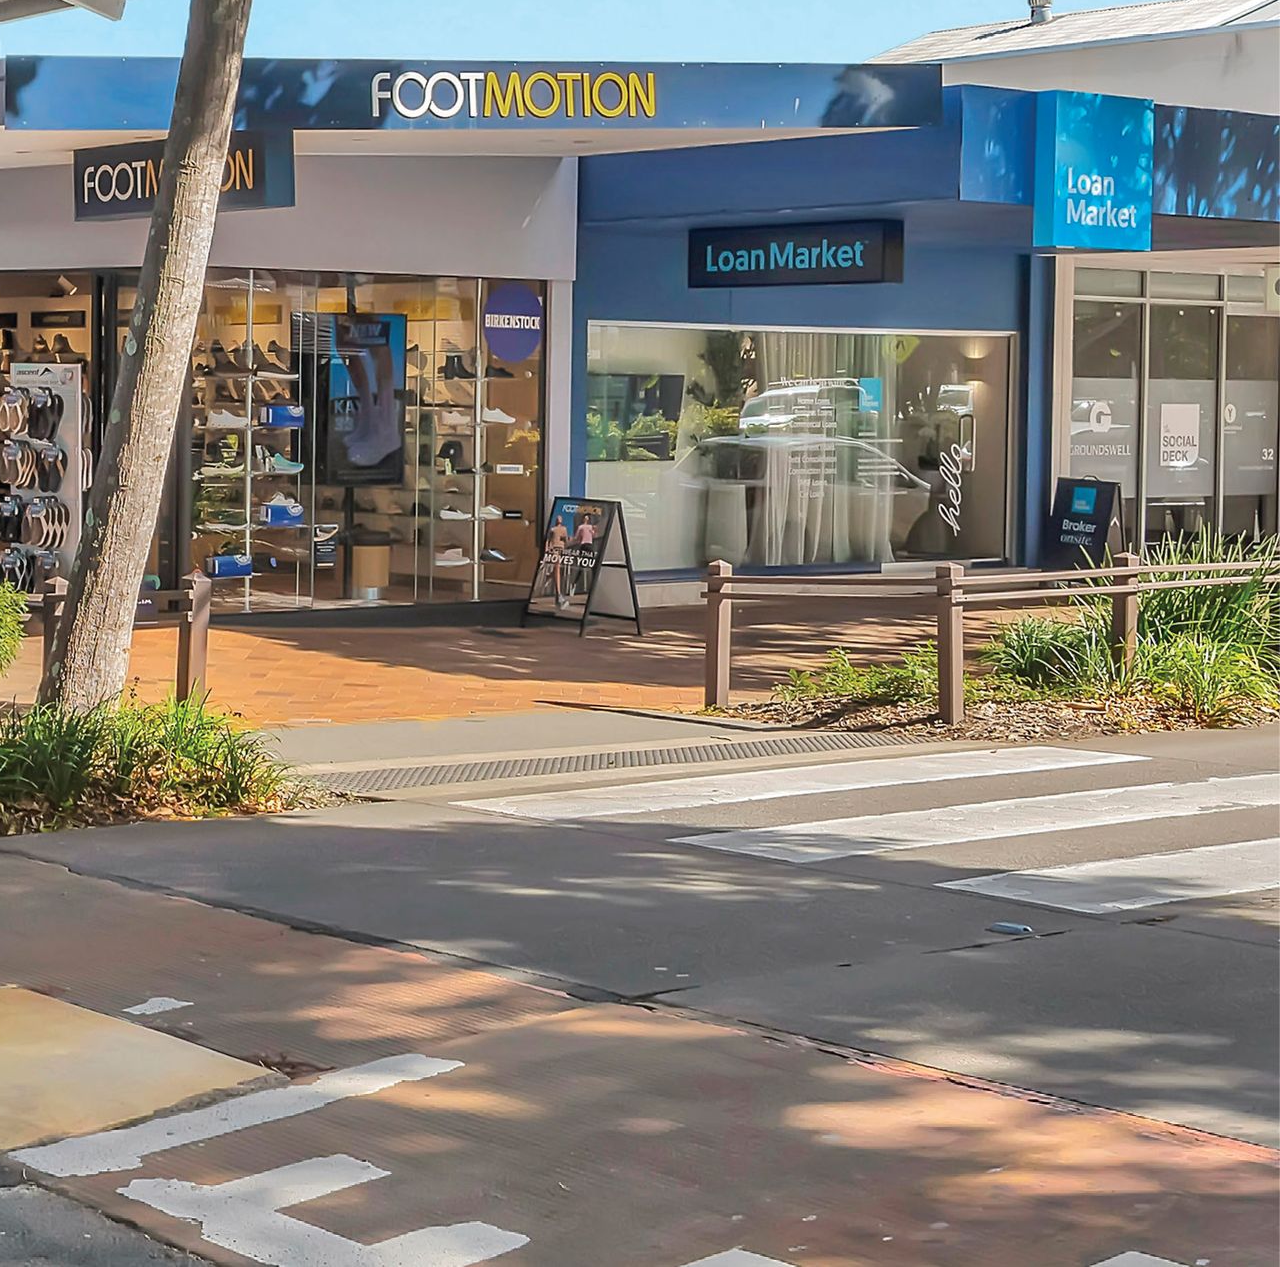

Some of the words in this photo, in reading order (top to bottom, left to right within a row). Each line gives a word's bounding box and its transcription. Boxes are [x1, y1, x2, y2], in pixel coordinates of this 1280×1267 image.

[371, 71, 656, 118] FOOTMOTION
[83, 148, 254, 203] FOOTMON
[1067, 166, 1115, 196] Loan
[1066, 198, 1137, 229] Market
[706, 245, 765, 272] Loan
[769, 238, 864, 270] Market
[485, 313, 541, 330] BIRKENSTOCK
[1162, 435, 1198, 447] SOCIAL
[1162, 450, 1189, 462] DECK
[1261, 448, 1274, 461] 32
[938, 443, 962, 537] hello
[1062, 518, 1097, 533] Broker
[544, 553, 574, 565] MOVES
[577, 557, 596, 568] YOU
